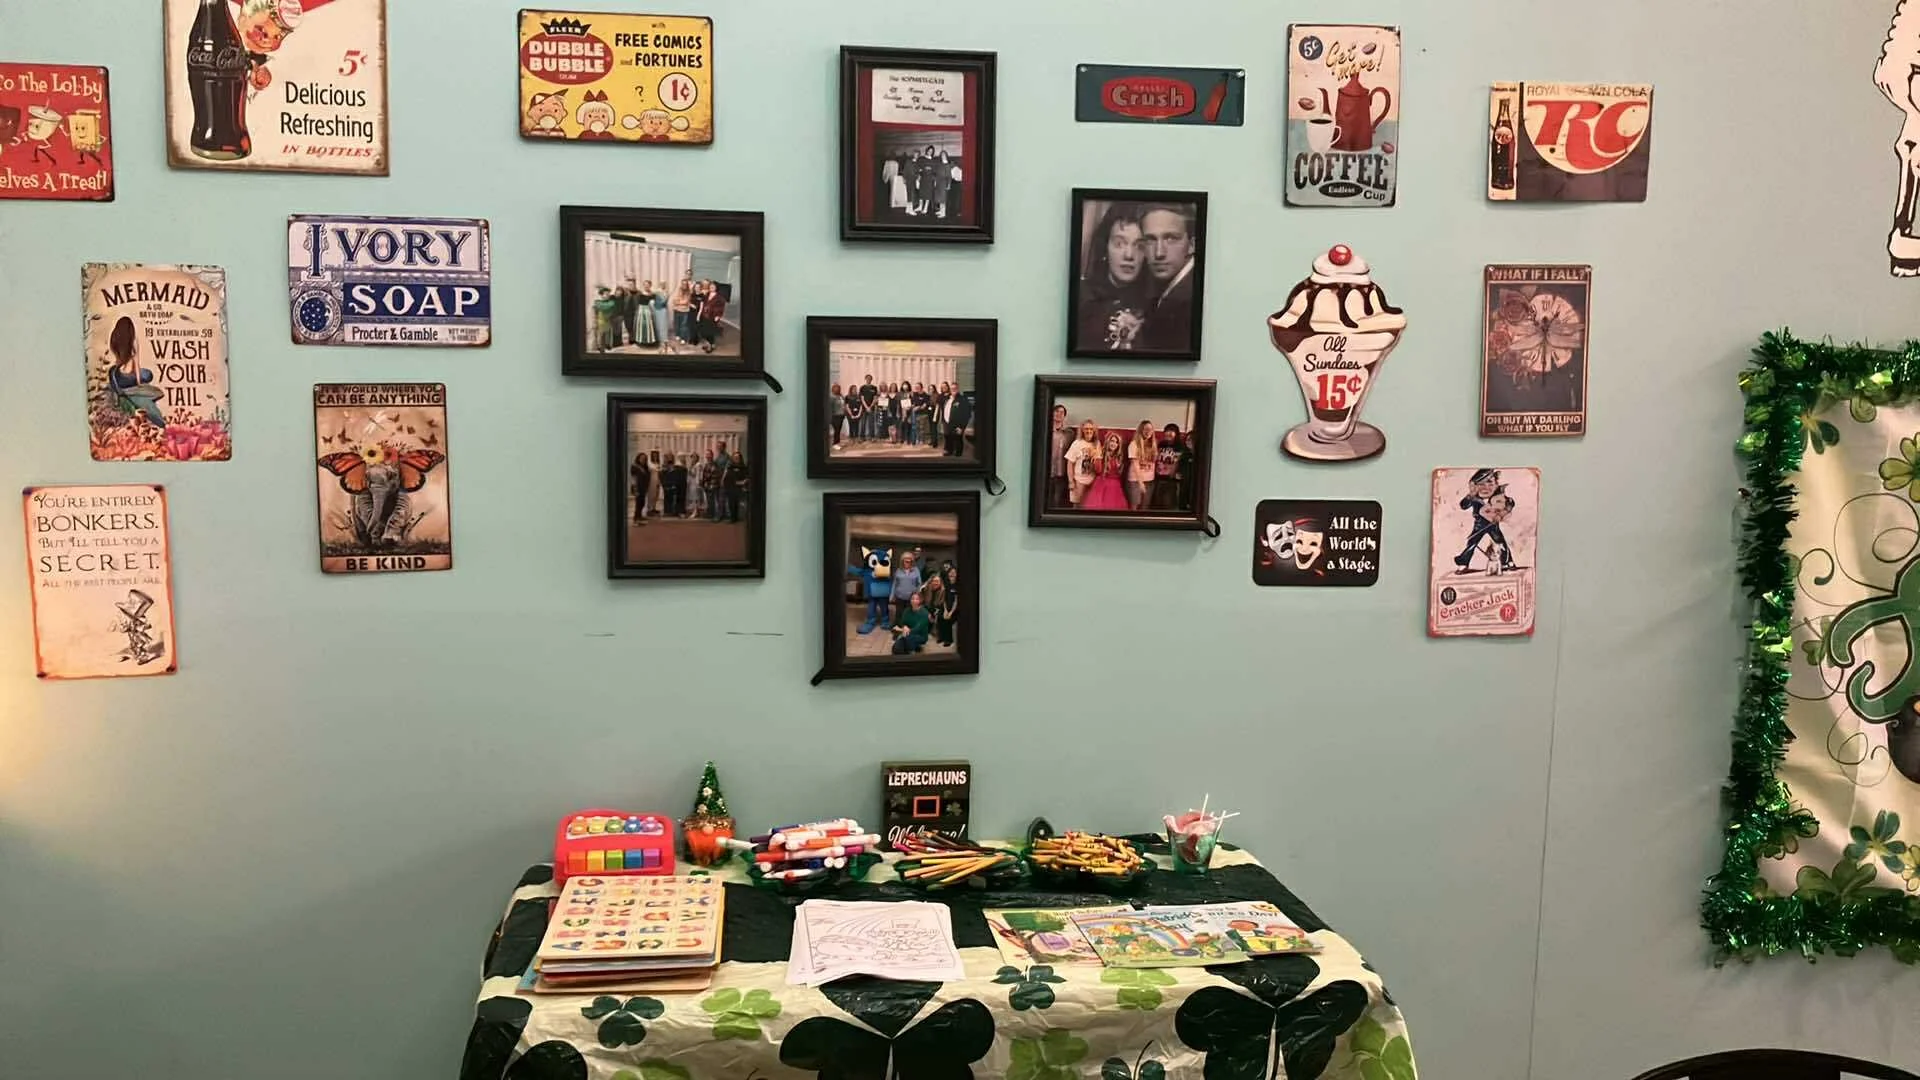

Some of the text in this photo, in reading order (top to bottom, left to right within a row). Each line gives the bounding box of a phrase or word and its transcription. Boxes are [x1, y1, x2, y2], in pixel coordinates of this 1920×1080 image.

[528, 40, 605, 57] DUBBLE
[615, 33, 702, 50] FREE COMICS
[635, 52, 703, 68] FORTUNES
[1325, 41, 1357, 68] Get
[529, 57, 605, 73] BUBBLE
[18, 72, 48, 92] The
[52, 73, 103, 103] Lobby
[285, 81, 367, 107] Delicious
[671, 79, 690, 101] 1¢
[1112, 85, 1184, 107] Crush
[1614, 86, 1648, 97] COLA
[280, 112, 373, 143] Refreshing
[1527, 100, 1648, 170] RC
[282, 144, 373, 158] IN BOTTLES
[1294, 152, 1389, 191] COFFEE
[44, 173, 57, 192] A
[59, 171, 107, 191] Treat!
[1363, 190, 1386, 202] Cup
[304, 224, 471, 279] IVORY
[1491, 269, 1527, 280] WHAT
[1531, 270, 1543, 280] IF
[101, 282, 210, 310] MERMAID
[349, 285, 480, 316] SOAP
[352, 326, 387, 341] Procter
[400, 326, 438, 341] Gamble
[150, 339, 210, 360] WASH
[1323, 336, 1347, 353] All
[1303, 354, 1362, 373] Sundaes
[157, 363, 207, 384] YOUR
[165, 387, 202, 407] TAIL
[318, 393, 441, 404] CAN BE ANYTHING
[1317, 374, 1362, 409] 15¢
[1487, 415, 1581, 425] OH BUT MY DARLING
[1498, 425, 1524, 433] WHAT
[91, 495, 156, 507] ENTIRELY
[37, 513, 159, 533] BONKERS.
[1329, 517, 1377, 530] All the
[93, 537, 119, 547] TELL
[122, 536, 147, 547] YOU
[150, 537, 160, 545] A
[1329, 537, 1376, 550] World's
[40, 552, 160, 573] SECRET.
[346, 557, 426, 570] BE KIND
[1327, 556, 1375, 573] a Stage.
[1440, 598, 1485, 618] Cracker
[1486, 589, 1514, 605] Jack
[888, 770, 967, 786] LEPRECHAUNS
